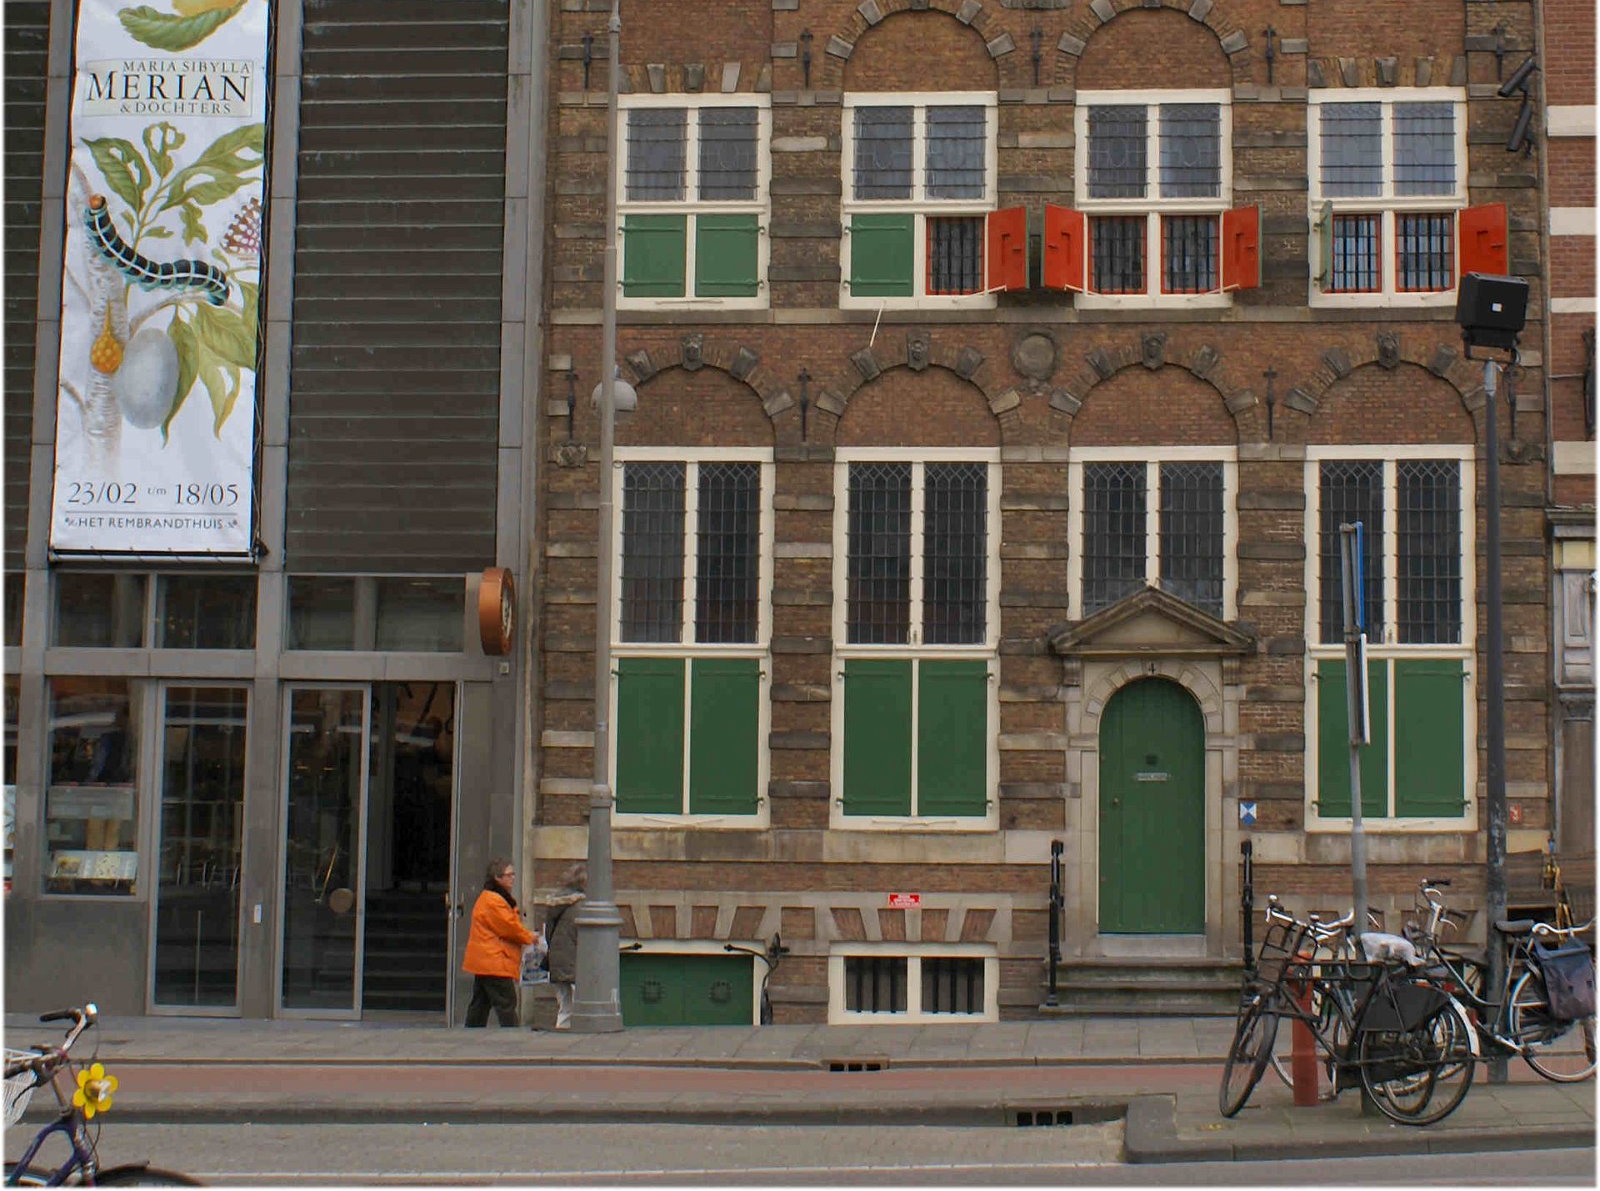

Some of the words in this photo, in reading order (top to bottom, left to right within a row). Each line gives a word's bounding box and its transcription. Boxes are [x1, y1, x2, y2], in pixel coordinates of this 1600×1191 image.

[122, 60, 176, 73] MARIA
[182, 61, 251, 74] SIBYLLA
[86, 70, 250, 103] MERIAN
[119, 105, 131, 114] &
[135, 101, 232, 114] DOCHTERS
[67, 481, 138, 506] 23/02
[175, 482, 239, 507] 18/05
[78, 517, 105, 528] HET
[108, 518, 224, 530] REMBRANDTHUIS
